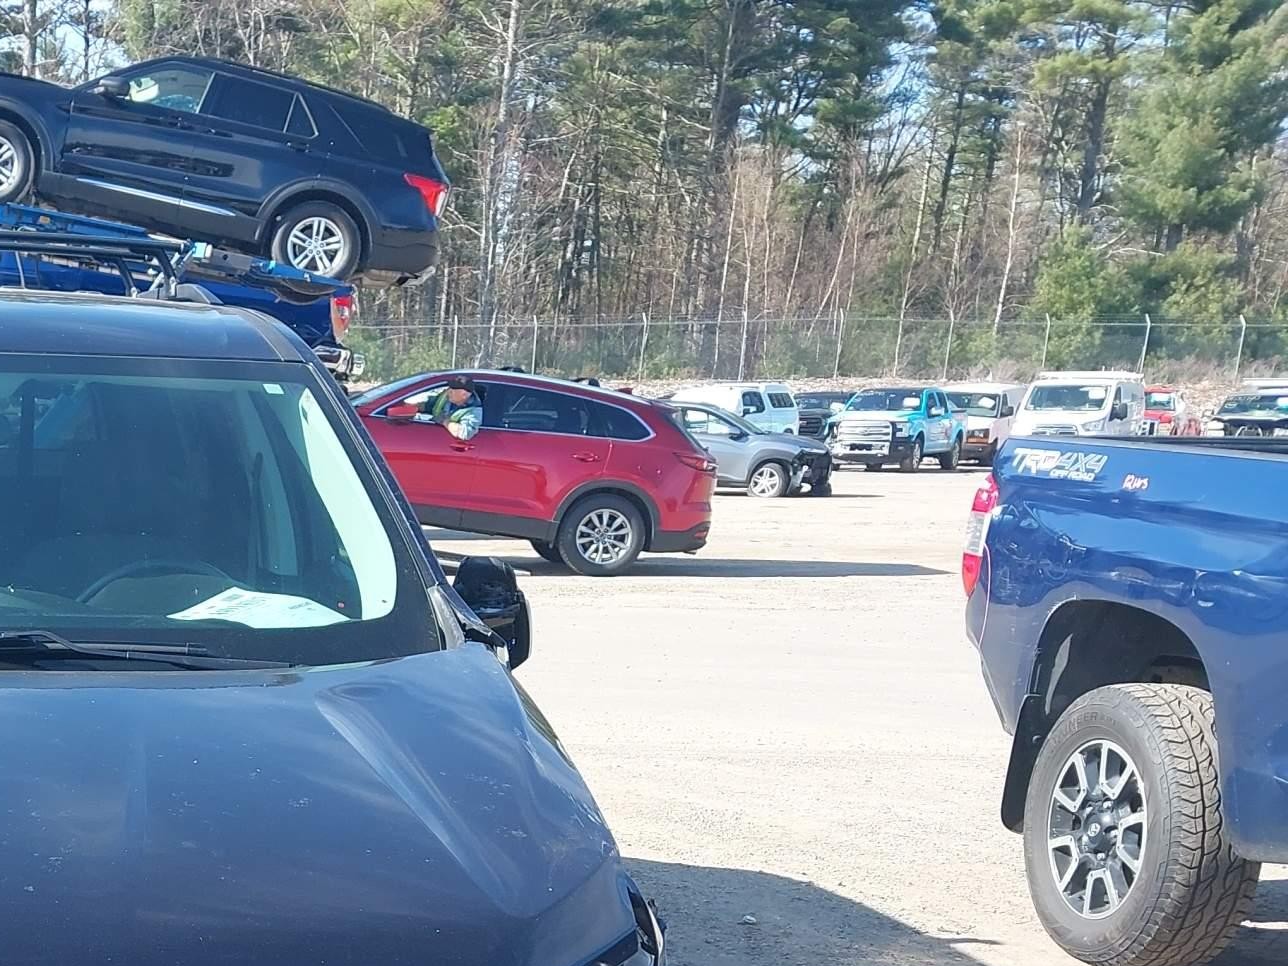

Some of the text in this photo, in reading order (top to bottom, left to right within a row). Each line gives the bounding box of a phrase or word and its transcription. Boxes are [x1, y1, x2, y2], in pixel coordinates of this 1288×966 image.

[1013, 448, 1060, 474] TRD
[1049, 470, 1095, 481] OFF ROAD
